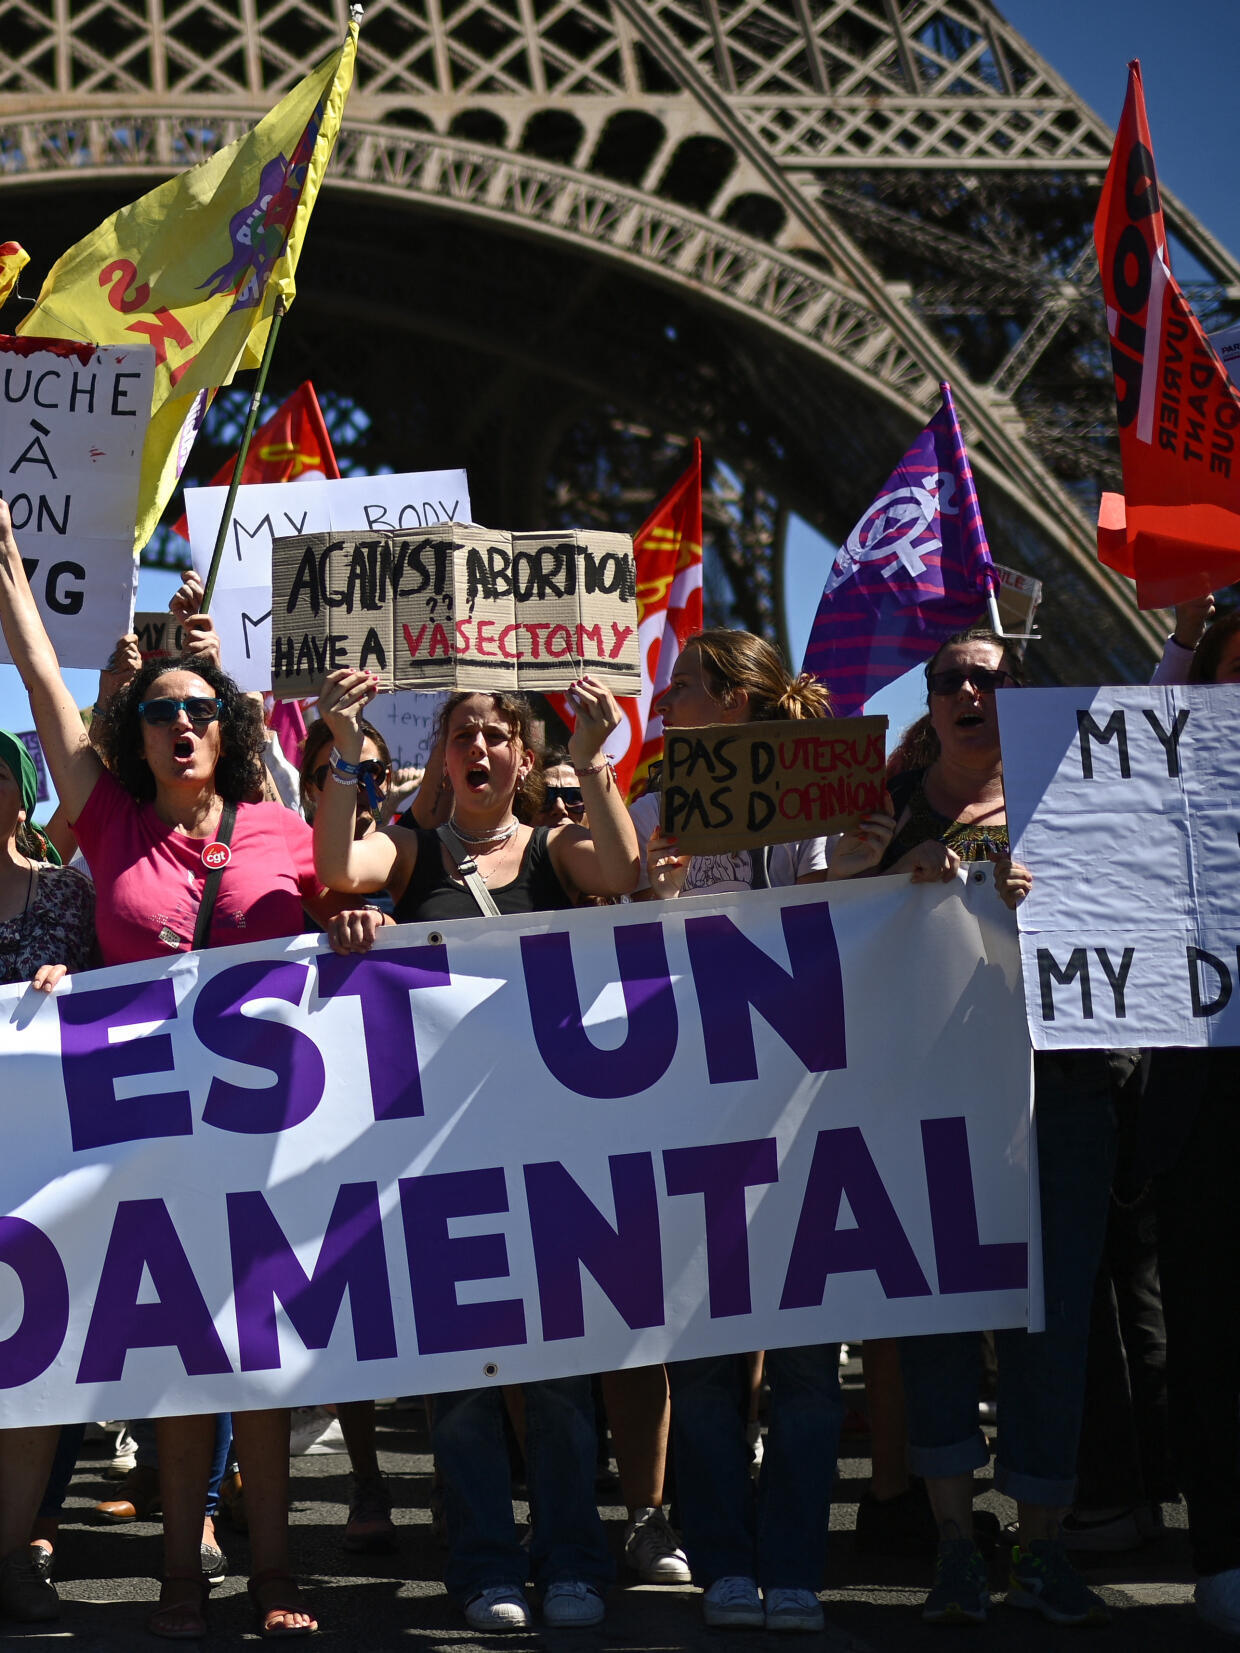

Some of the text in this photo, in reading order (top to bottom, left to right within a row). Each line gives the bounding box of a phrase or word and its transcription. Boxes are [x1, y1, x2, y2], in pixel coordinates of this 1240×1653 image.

[9, 418, 58, 479] À
[287, 538, 464, 616] AGAINST
[273, 619, 635, 679] HAVE A VASECTOMY
[668, 736, 738, 783] PAS
[1076, 709, 1191, 779] MY
[665, 785, 734, 834] PAS
[206, 850, 226, 864] cgt
[1036, 945, 1240, 1021] MY D
[57, 943, 451, 1152] EST
[520, 902, 847, 1099] UN
